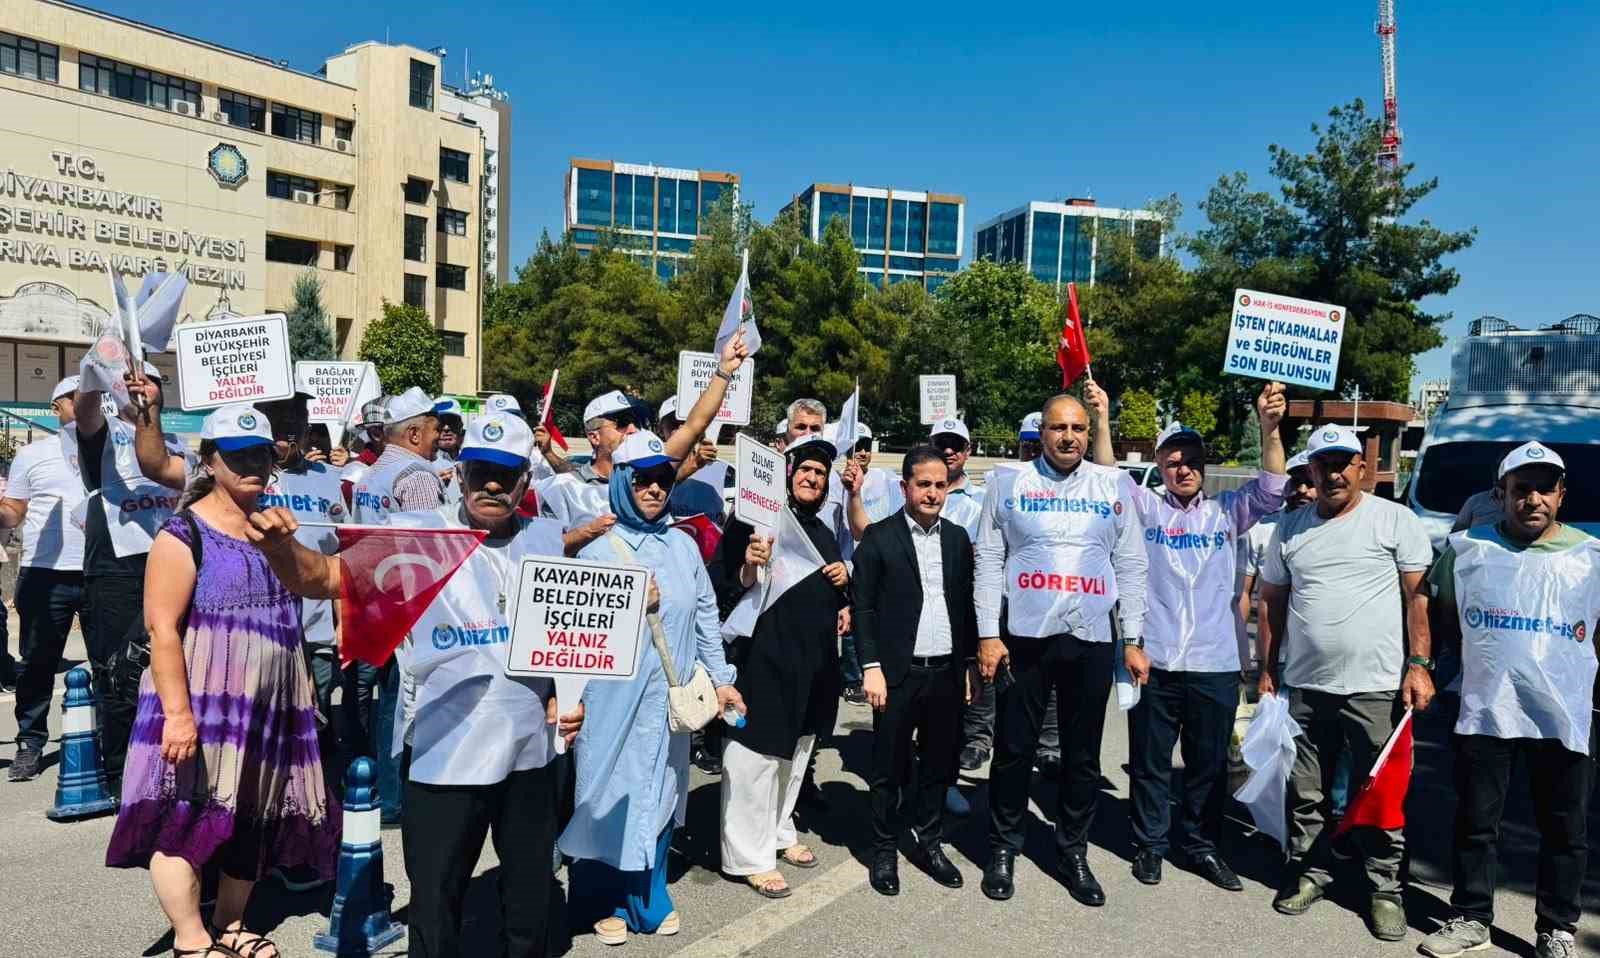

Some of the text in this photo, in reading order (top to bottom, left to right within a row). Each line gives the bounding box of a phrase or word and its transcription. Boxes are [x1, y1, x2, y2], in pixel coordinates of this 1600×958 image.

[52, 151, 105, 181] T.C.
[95, 219, 246, 264] BELEDİYESİ
[195, 325, 267, 342] DİYARBAKIR
[1235, 310, 1338, 344] İŞTEN ÇIKARMALAR
[194, 336, 271, 354] BÜYÜKŞEHİR
[1235, 336, 1331, 364] ve SÜRGÜNLER
[201, 349, 266, 367] BELEDİYESİ
[1230, 354, 1331, 383] SON BULUNSUN
[211, 361, 258, 378] İŞÇİLERİ
[215, 374, 257, 387] YALNIZ
[315, 366, 355, 376] BAĞLAR
[209, 385, 265, 400] DEĞİLDİR
[316, 386, 352, 397] İŞÇİLER
[312, 406, 342, 415] DEĞİL
[751, 451, 775, 472] ZULME
[1020, 494, 1112, 519] hizmet-iş
[1155, 525, 1225, 550] hizmet-iş
[533, 566, 634, 590] KAYAPINAR
[1018, 569, 1106, 595] GÖREVLİ
[532, 587, 631, 610] BELEDİYESİ
[544, 606, 615, 630] İŞÇİLERİ
[1483, 609, 1575, 641] hizmet-iş
[546, 630, 608, 649] YALNIZ
[530, 648, 614, 670] DEĞİLDİR
